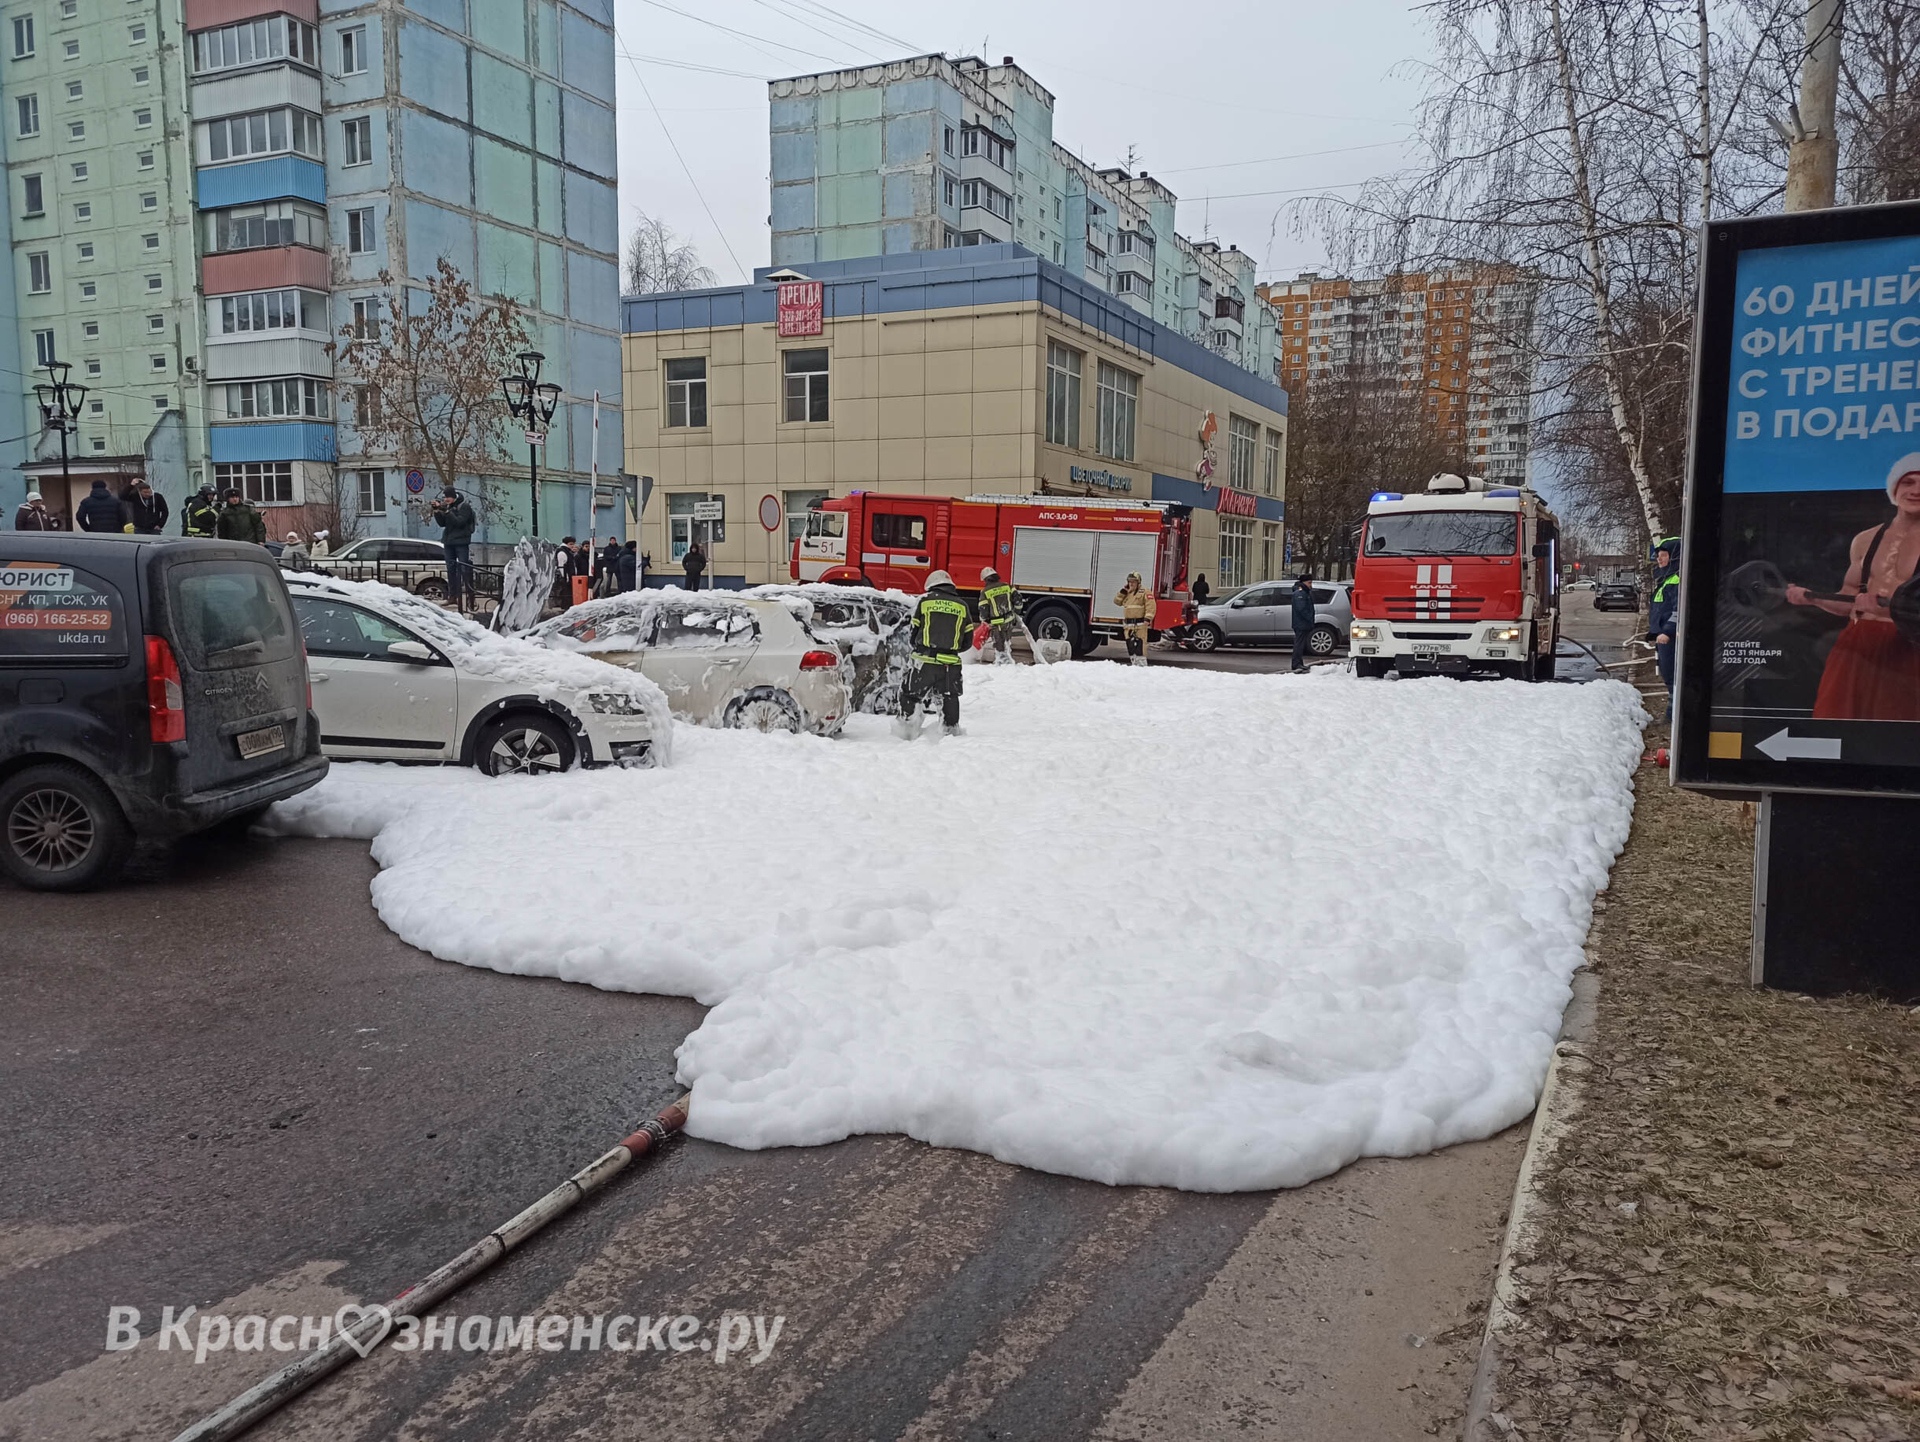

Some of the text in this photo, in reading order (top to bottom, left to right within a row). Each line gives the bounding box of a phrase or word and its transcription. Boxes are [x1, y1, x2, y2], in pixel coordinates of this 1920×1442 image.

[780, 283, 821, 306] АРЕНДА
[1742, 265, 1920, 317] 60 ДНЕЙ
[1740, 316, 1920, 357] ФИТНЕС
[1738, 360, 1920, 399] С ТРЕНЕ
[1736, 411, 1761, 440] В
[1072, 466, 1109, 486] ЦВЕТОЧНЫЙ
[821, 541, 834, 553] 51
[0, 572, 70, 587] ЮРИСТ
[54, 594, 87, 607] ТСЖ,
[91, 595, 108, 606] УК
[927, 605, 962, 614] РОССИИ
[5, 612, 108, 627] (966) 166-25-52
[58, 632, 106, 644] ukda.ru
[1723, 640, 1761, 648] УСПЕЙТЕ
[1722, 649, 1736, 657] ДО
[1748, 649, 1782, 657] ЯНВАРЯ
[1743, 657, 1767, 665] ГОДА
